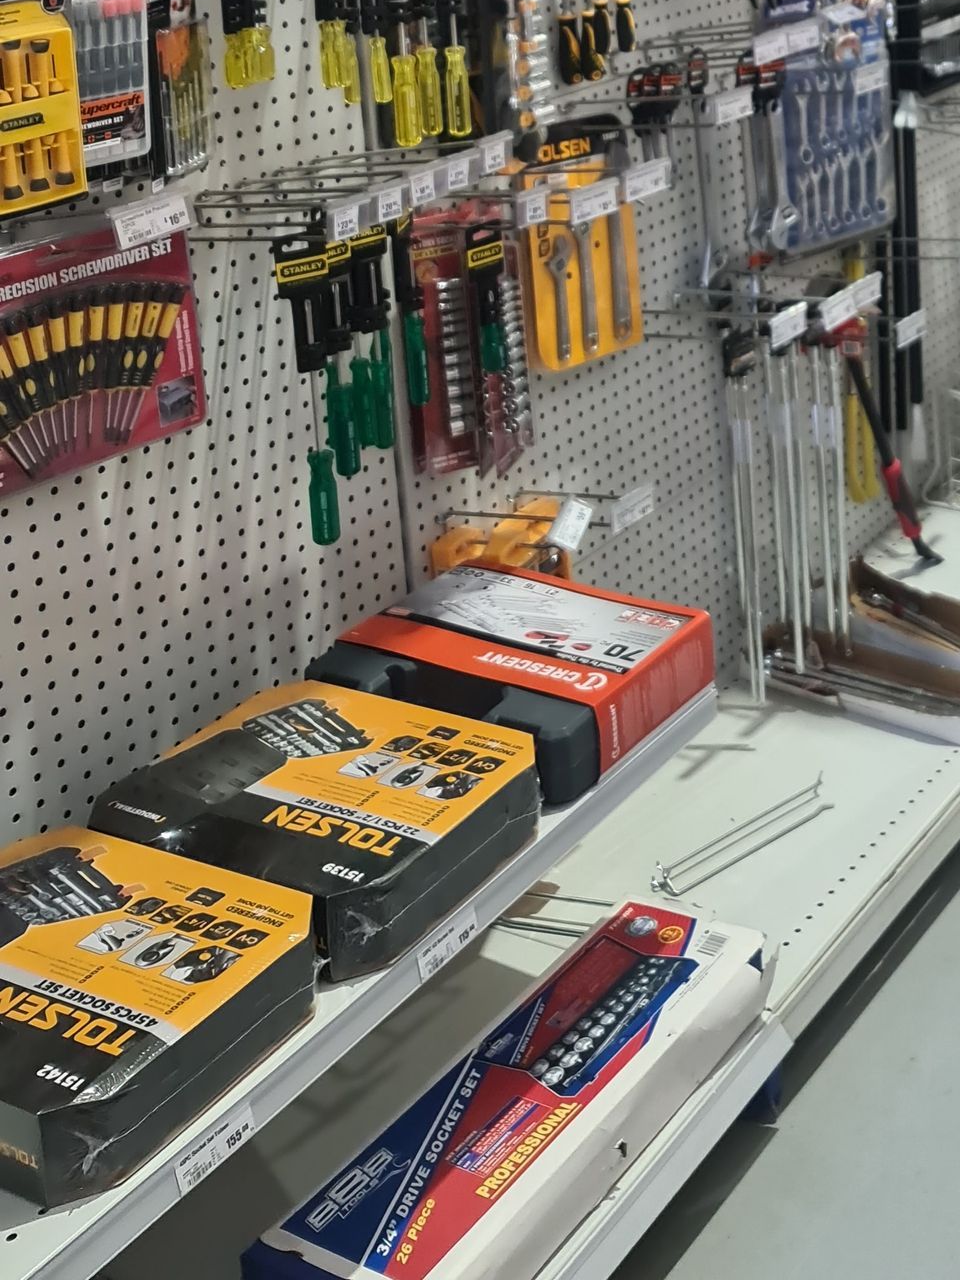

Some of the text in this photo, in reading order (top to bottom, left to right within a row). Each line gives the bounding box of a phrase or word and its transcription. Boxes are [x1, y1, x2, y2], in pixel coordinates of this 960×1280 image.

[2, 116, 42, 131] STANLEY
[538, 137, 591, 163] OLSEN
[60, 245, 151, 284] SCREWDRIVER
[152, 238, 172, 258] SET
[328, 245, 347, 257] NLEY
[473, 246, 501, 260] STANLEY
[283, 261, 323, 276] STANLEY
[603, 643, 645, 662] 70
[478, 650, 583, 683] CRESCENT
[114, 801, 162, 821] INDUSTRIAL
[297, 796, 316, 808] SET
[315, 801, 358, 818] SOCKET
[264, 804, 403, 858] TOLSEN
[383, 819, 403, 831] PCS
[403, 826, 420, 836] 22
[321, 862, 366, 883] 15139
[33, 979, 159, 1028] 45PCS SOCKET SET
[0, 986, 137, 1057] TOLSEN
[36, 1063, 86, 1091] 15142
[396, 1164, 432, 1219] DRIVE
[425, 1101, 465, 1164] SOCKET
[464, 1068, 482, 1099] SET
[474, 1100, 580, 1200] PROFESSIONAL
[343, 1177, 380, 1211] TOOLS
[396, 1197, 436, 1265] 26 Piece
